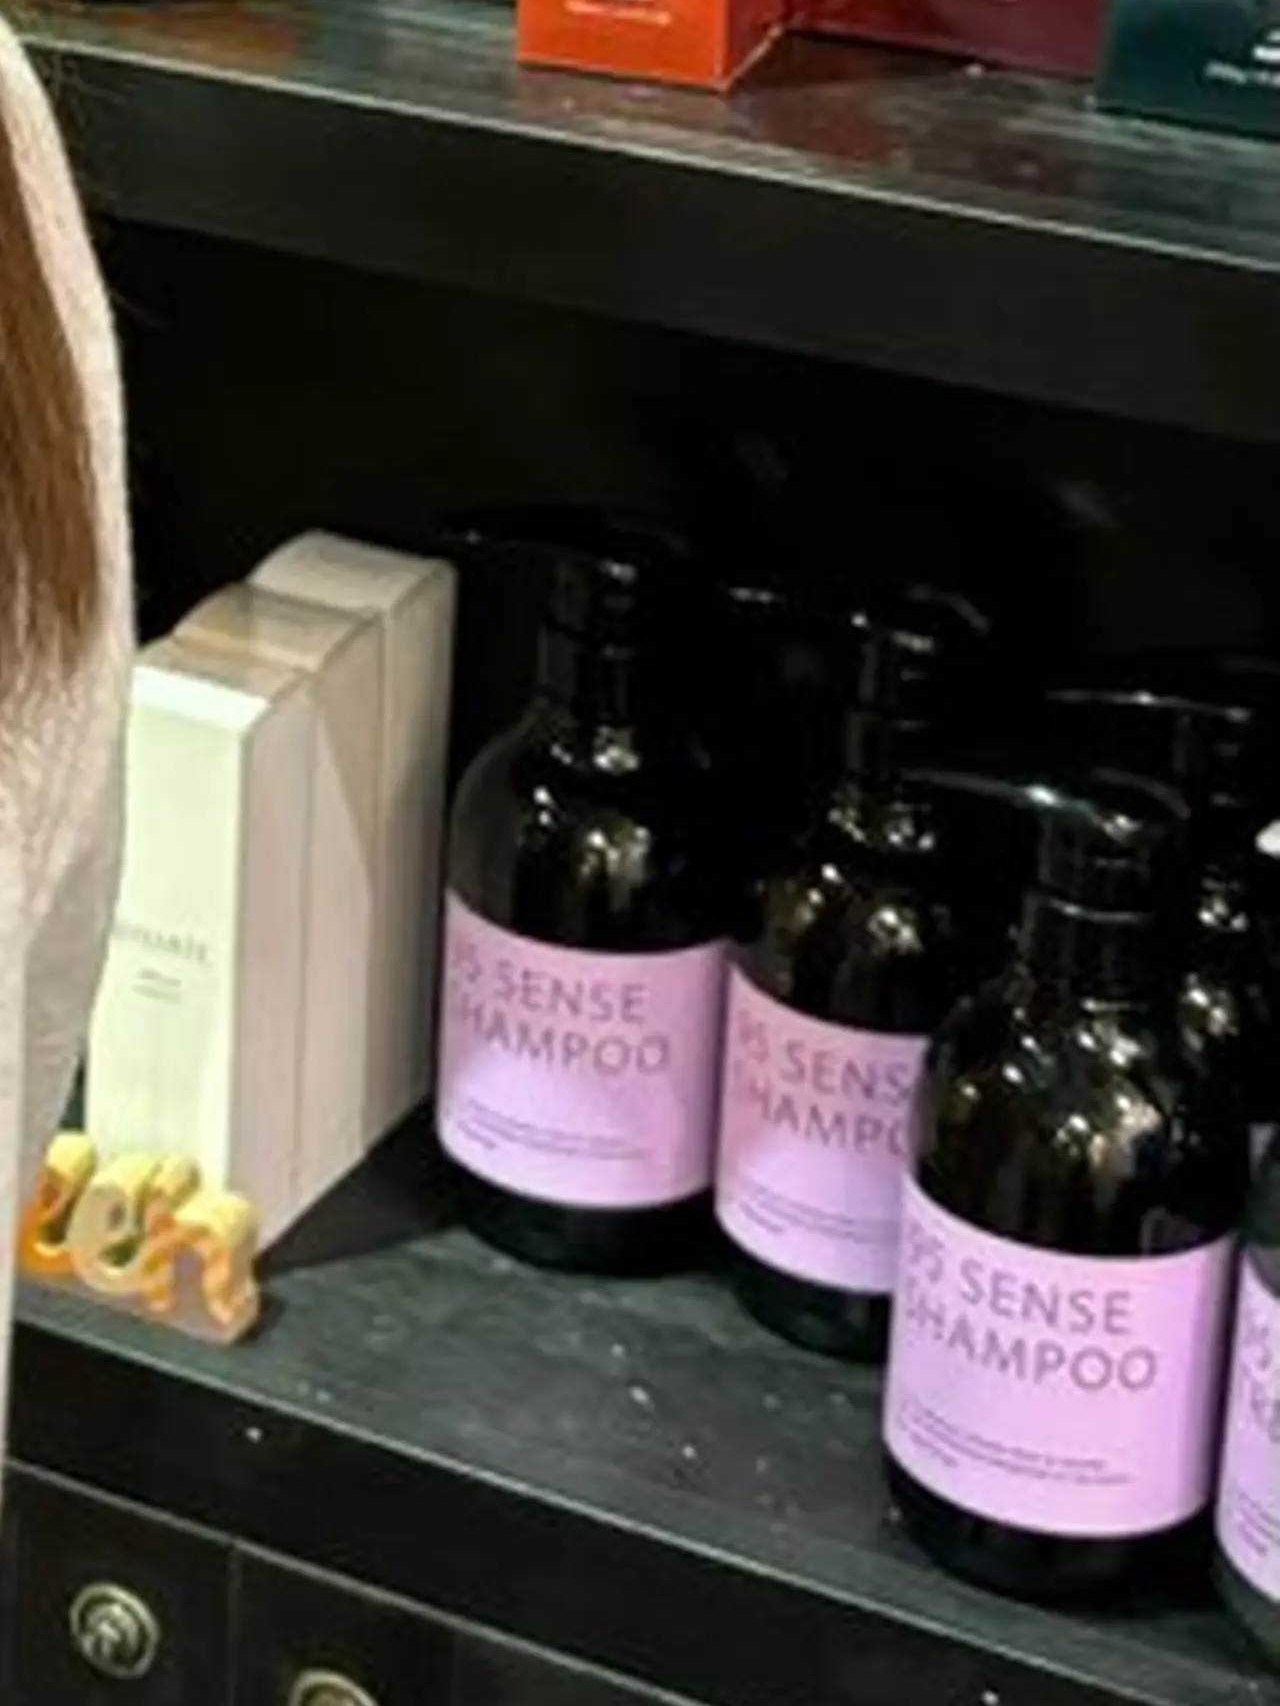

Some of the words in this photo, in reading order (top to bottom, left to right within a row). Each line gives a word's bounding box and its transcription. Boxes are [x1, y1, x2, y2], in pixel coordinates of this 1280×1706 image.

[493, 956, 648, 1026] SENSE
[778, 1038, 914, 1108] SENS
[905, 1276, 1158, 1392] SHAMPOO
[958, 1256, 1133, 1337] SENSE
